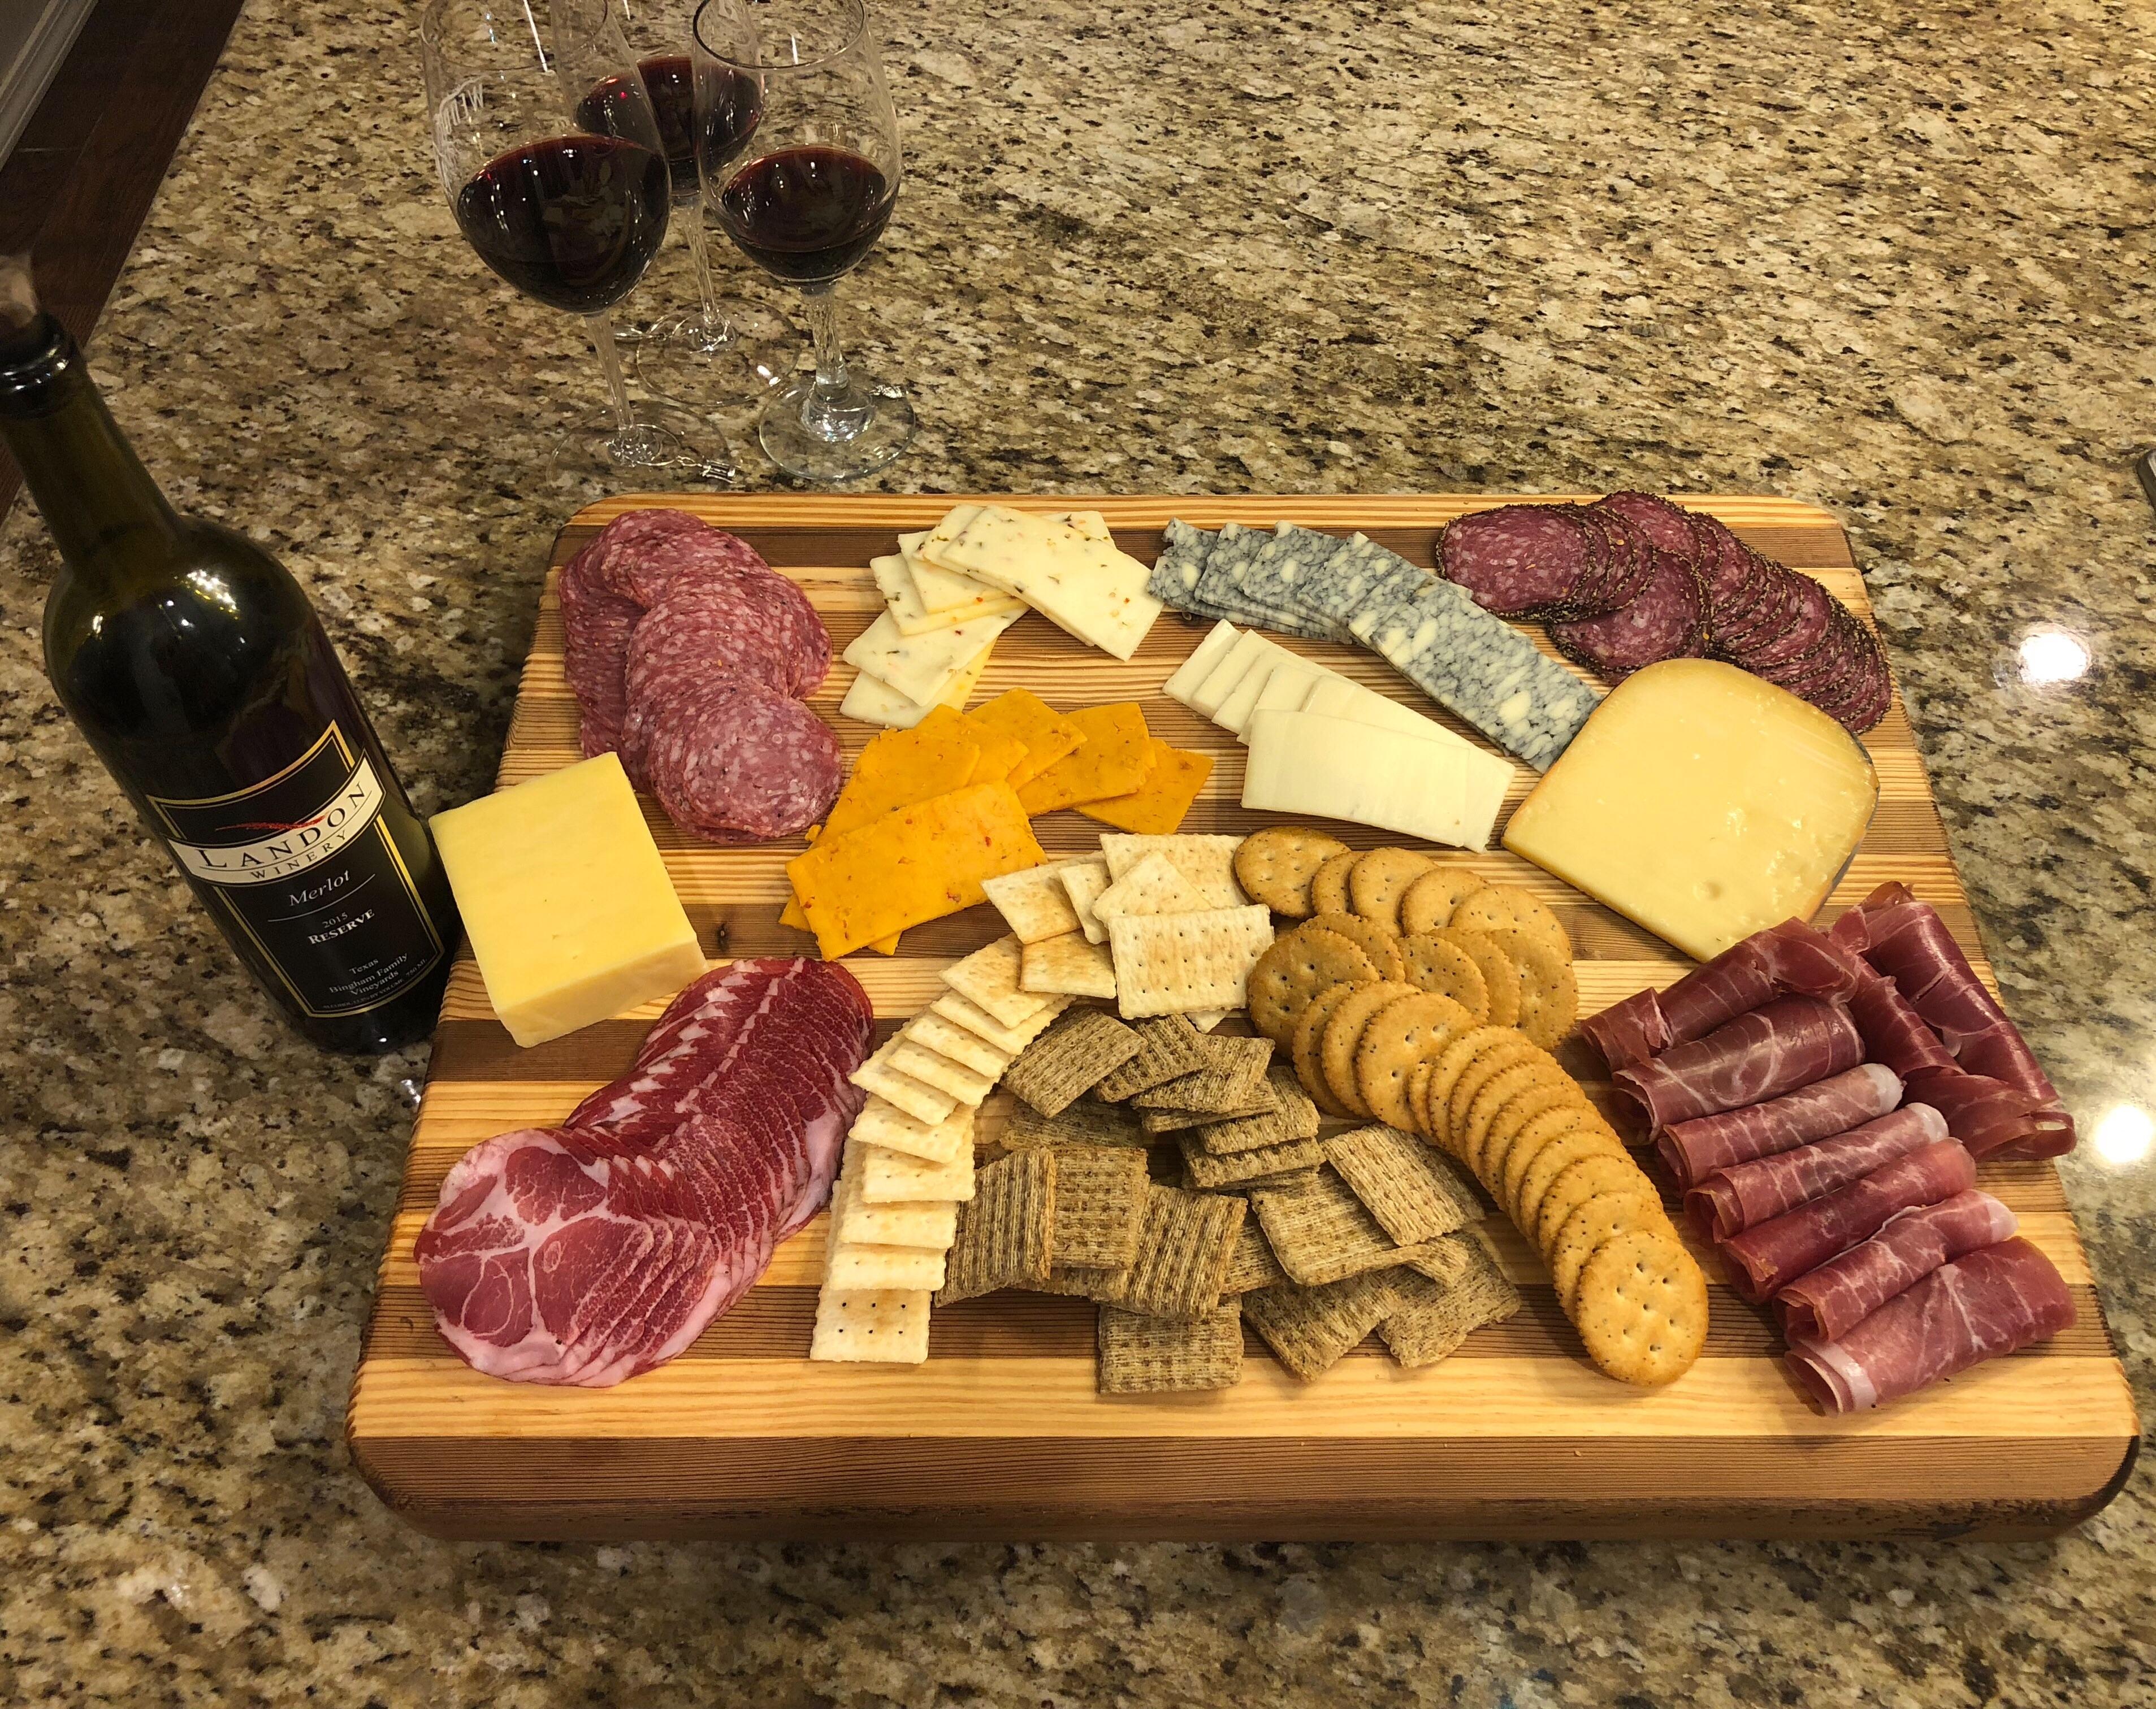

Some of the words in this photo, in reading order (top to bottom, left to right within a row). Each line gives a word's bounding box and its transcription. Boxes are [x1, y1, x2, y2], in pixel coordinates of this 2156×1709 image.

[196, 782, 366, 868] LANDON
[250, 830, 347, 879] WINERY
[289, 869, 350, 906] Merlot
[307, 909, 375, 944] RESERVE
[322, 912, 348, 929] 2015
[329, 975, 375, 994] Bingham
[376, 952, 408, 977] Family
[349, 958, 379, 975] Texas
[349, 970, 399, 995] Vineyards
